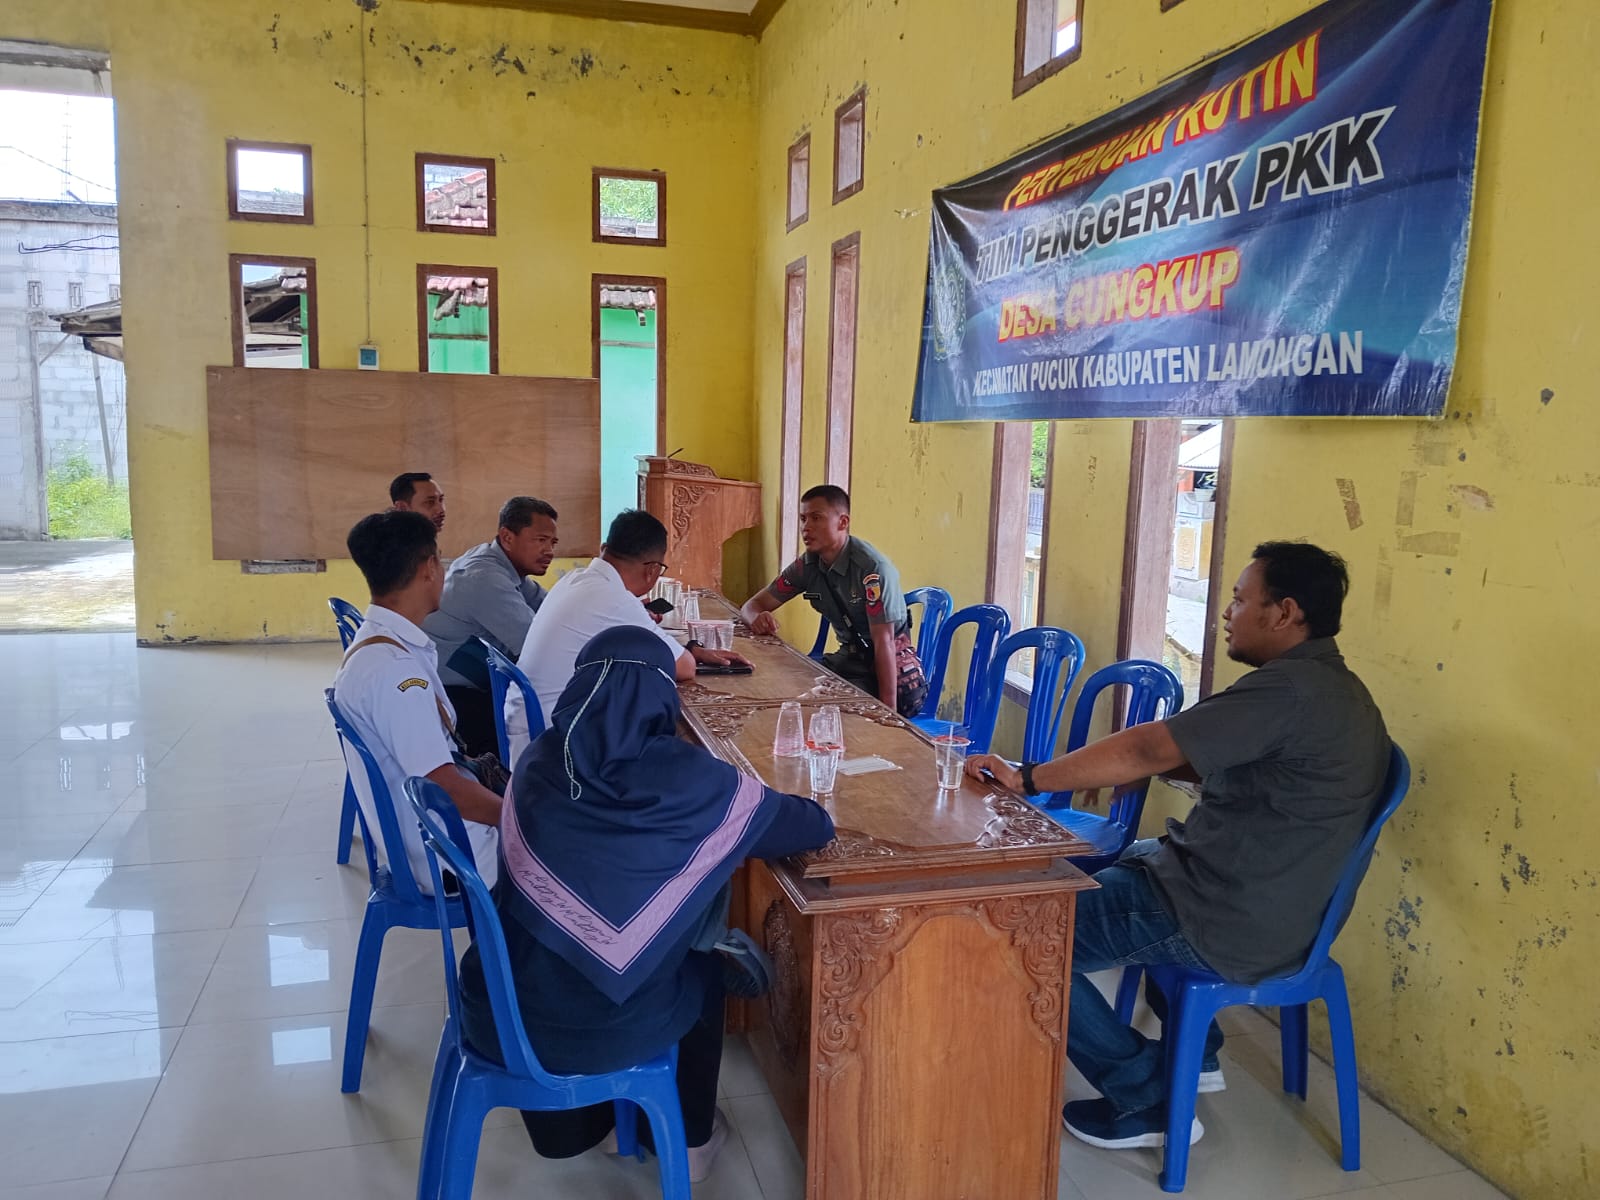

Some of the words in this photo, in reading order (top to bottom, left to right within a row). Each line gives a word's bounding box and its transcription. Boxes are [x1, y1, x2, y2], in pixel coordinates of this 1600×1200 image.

[1173, 28, 1323, 145] RUTIN
[975, 231, 1017, 285] TIM
[1018, 152, 1249, 273] PENGGERAK
[1248, 105, 1397, 211] PKK
[998, 290, 1057, 342] DESA
[1064, 246, 1241, 330] CUNGKUP
[1031, 356, 1079, 392] PUCUK
[1082, 345, 1200, 388] KABUPATEN
[1207, 330, 1363, 383] LAMONGAN
